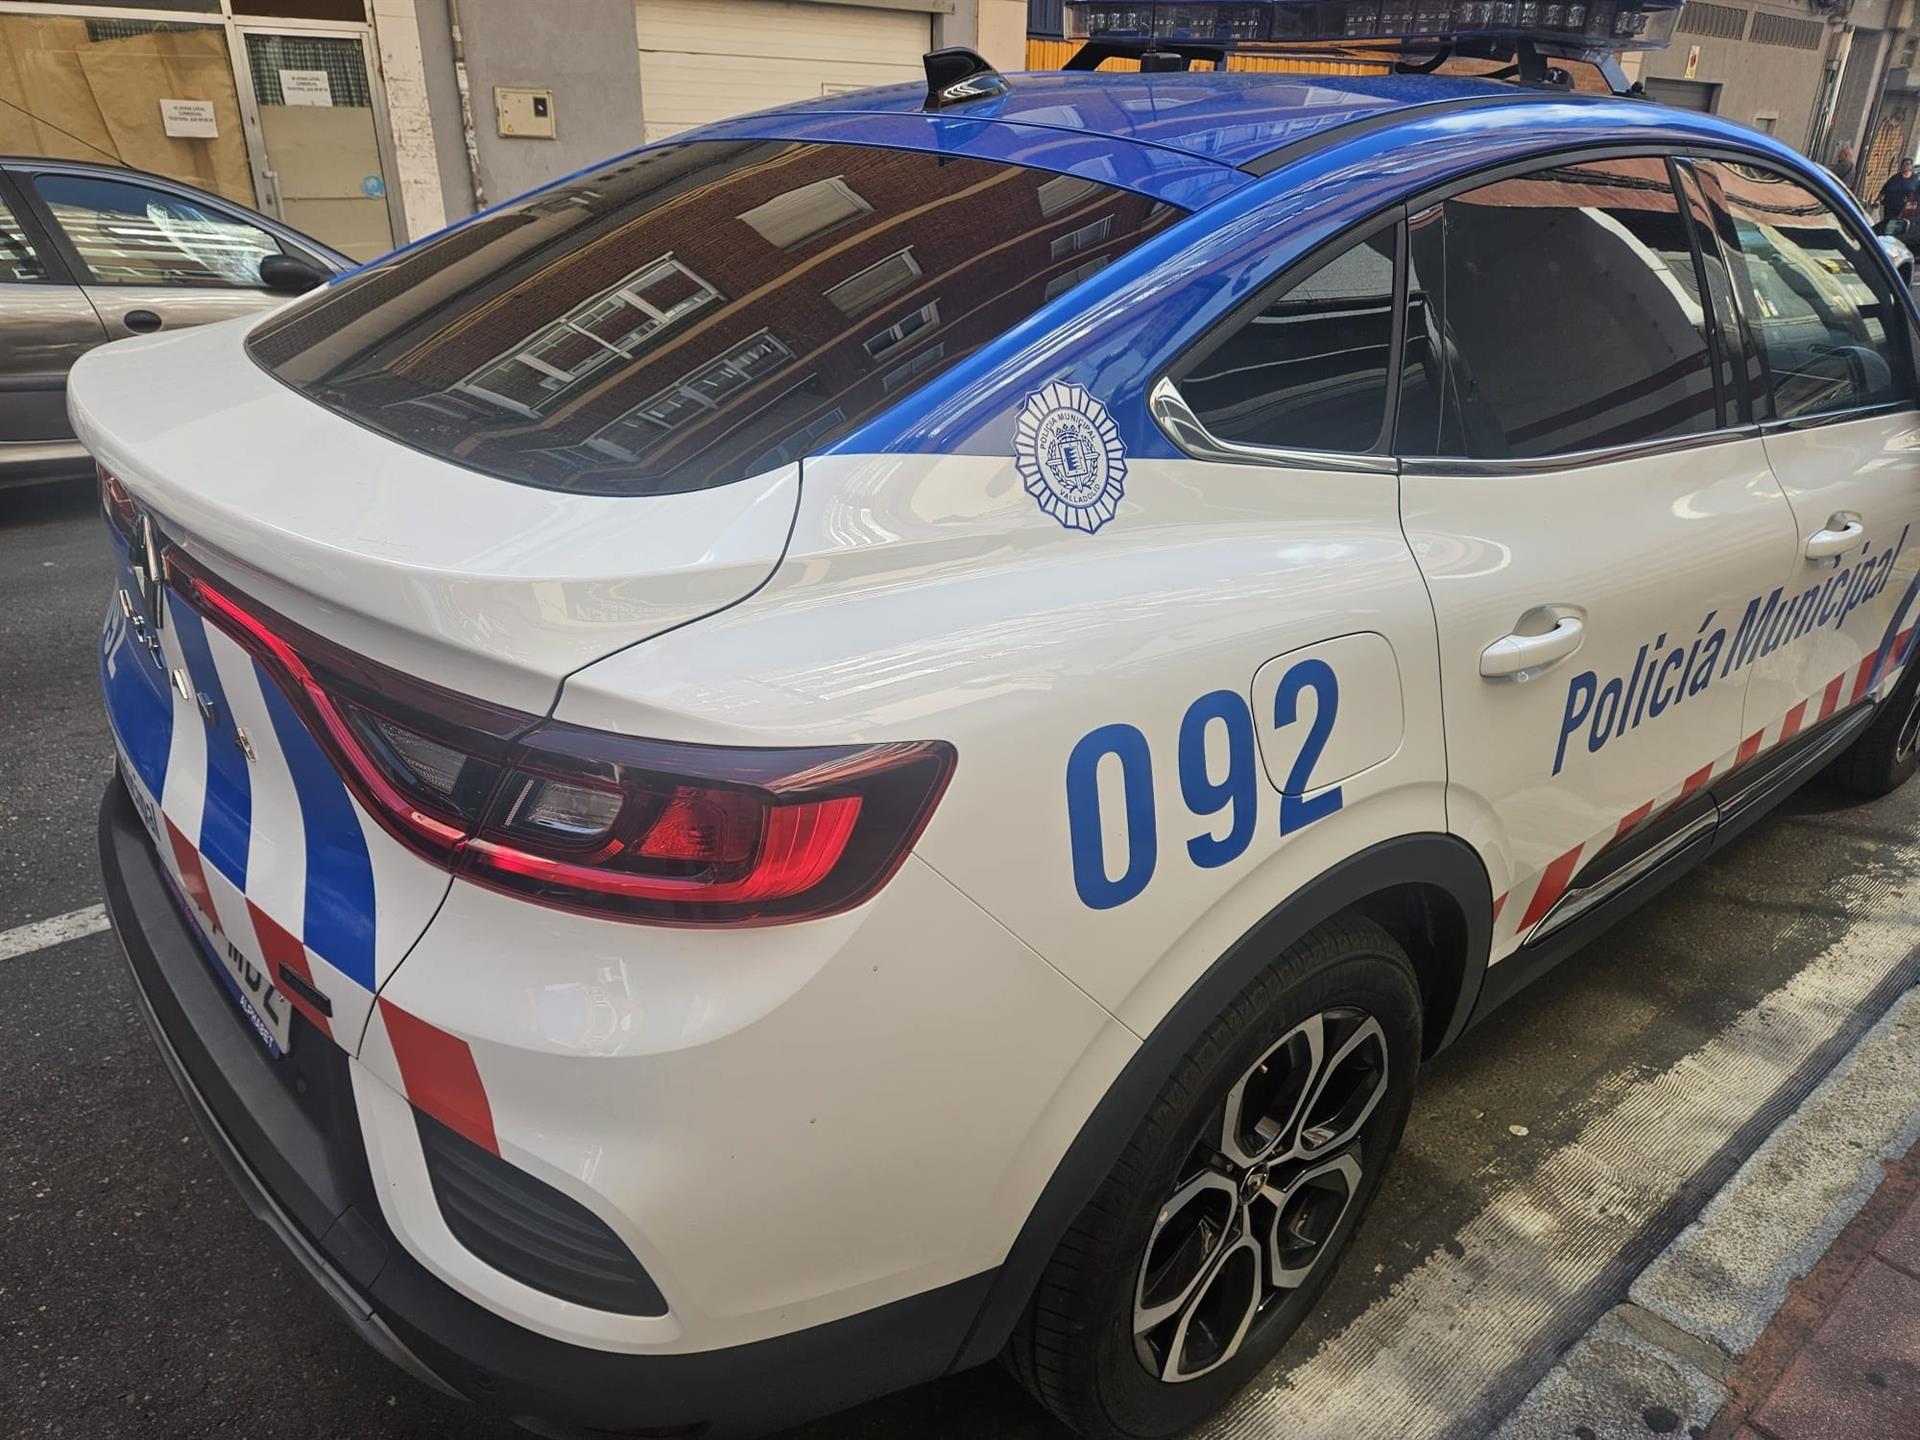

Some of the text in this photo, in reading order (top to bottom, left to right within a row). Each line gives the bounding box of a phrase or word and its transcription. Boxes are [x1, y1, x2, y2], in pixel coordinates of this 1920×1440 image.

[1057, 412, 1097, 443] MUNICIPAL
[1060, 483, 1101, 503] VALLADOLID
[1552, 523, 1911, 777] Policía Municipal
[1066, 658, 1344, 910] 092
